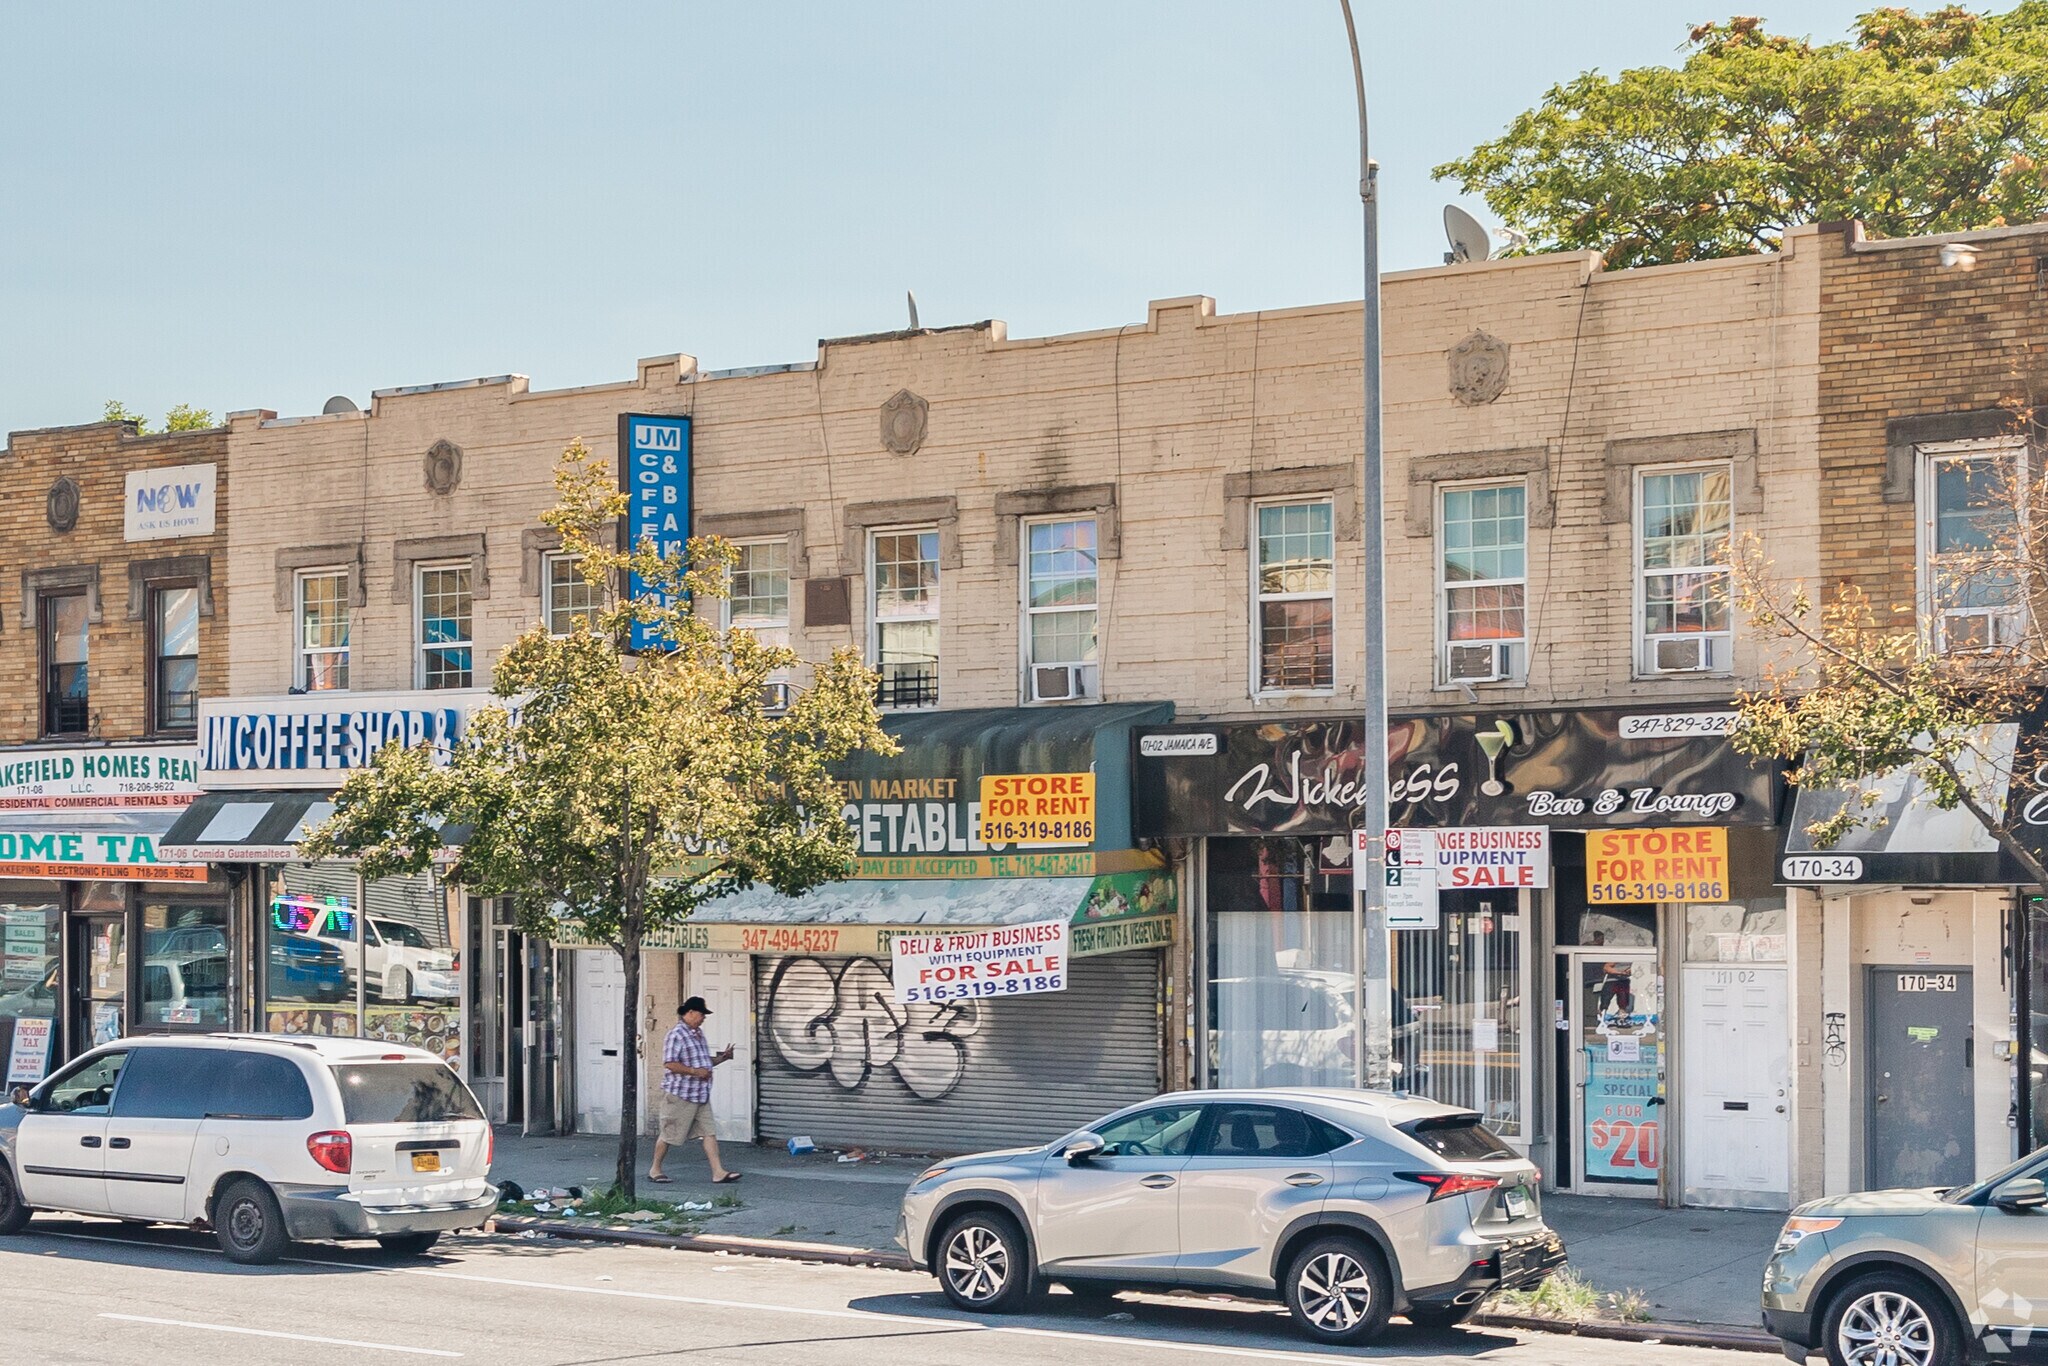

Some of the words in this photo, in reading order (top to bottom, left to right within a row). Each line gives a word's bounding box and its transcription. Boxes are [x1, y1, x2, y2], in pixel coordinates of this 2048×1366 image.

[637, 429, 677, 447] JM
[662, 455, 677, 474] &
[137, 483, 201, 513] NOW
[137, 519, 156, 530] ASK
[159, 519, 171, 529] US
[173, 518, 199, 528] HOW!
[196, 716, 230, 771] JM
[235, 713, 342, 770] COFFEE
[435, 708, 453, 767] &
[1164, 738, 1196, 751] JAMAICA
[83, 755, 150, 779] HOMES
[70, 784, 95, 794] L.L.C.
[119, 782, 175, 793] 718-206-9622
[870, 779, 957, 800] MARKET
[994, 777, 1084, 797] STORE
[1224, 751, 1459, 811] Wickeess
[55, 797, 119, 808] COMMERCIAL
[124, 796, 168, 806] RENTALS
[988, 799, 1029, 817] FOR
[1036, 797, 1090, 815] RENT
[1527, 790, 1585, 816] Bar
[1593, 789, 1625, 815] &
[1630, 788, 1736, 818] Lounge
[795, 803, 1005, 852] GETABLE
[984, 820, 1092, 839] 516-319-8186
[97, 835, 160, 863] TA
[1470, 831, 1541, 849] BUSINESS
[1602, 831, 1712, 857] STORE
[192, 848, 225, 859] Comida
[228, 848, 291, 859] Guatemalteca
[1439, 851, 1526, 865] UIPMENT
[48, 865, 99, 876] ELECTRONIC
[102, 866, 129, 877] FILING
[863, 860, 885, 874] DAY
[889, 860, 911, 874] EBT
[915, 859, 978, 875] ACCEPTED
[1452, 866, 1534, 886] SALE
[1596, 859, 1646, 882] FOR
[1654, 856, 1721, 880] RENT
[1787, 860, 1855, 877] 170-34
[1389, 869, 1398, 885] 2
[1592, 882, 1722, 900] 516-319-8186
[742, 929, 839, 952] 347-494-5237
[899, 938, 930, 956] DELI
[933, 938, 945, 953] &
[948, 933, 988, 951] FRUIT
[992, 924, 1061, 947] BUSINESS
[1073, 928, 1096, 952] FRESH
[929, 953, 962, 966] WITH
[966, 945, 1043, 962] EQUIPMENT
[919, 965, 977, 984] FOR
[987, 956, 1060, 978] SALE
[907, 974, 1062, 1002] 516-319-8186
[1899, 975, 1955, 991] 170-34
[17, 1027, 48, 1037] INCOME
[23, 1038, 39, 1048] TAX
[1605, 1067, 1652, 1081] BUCKET
[1603, 1084, 1653, 1096] SPECIAL
[1604, 1105, 1612, 1116] 6
[1617, 1105, 1642, 1117] FOR
[1591, 1118, 1658, 1169] $20
